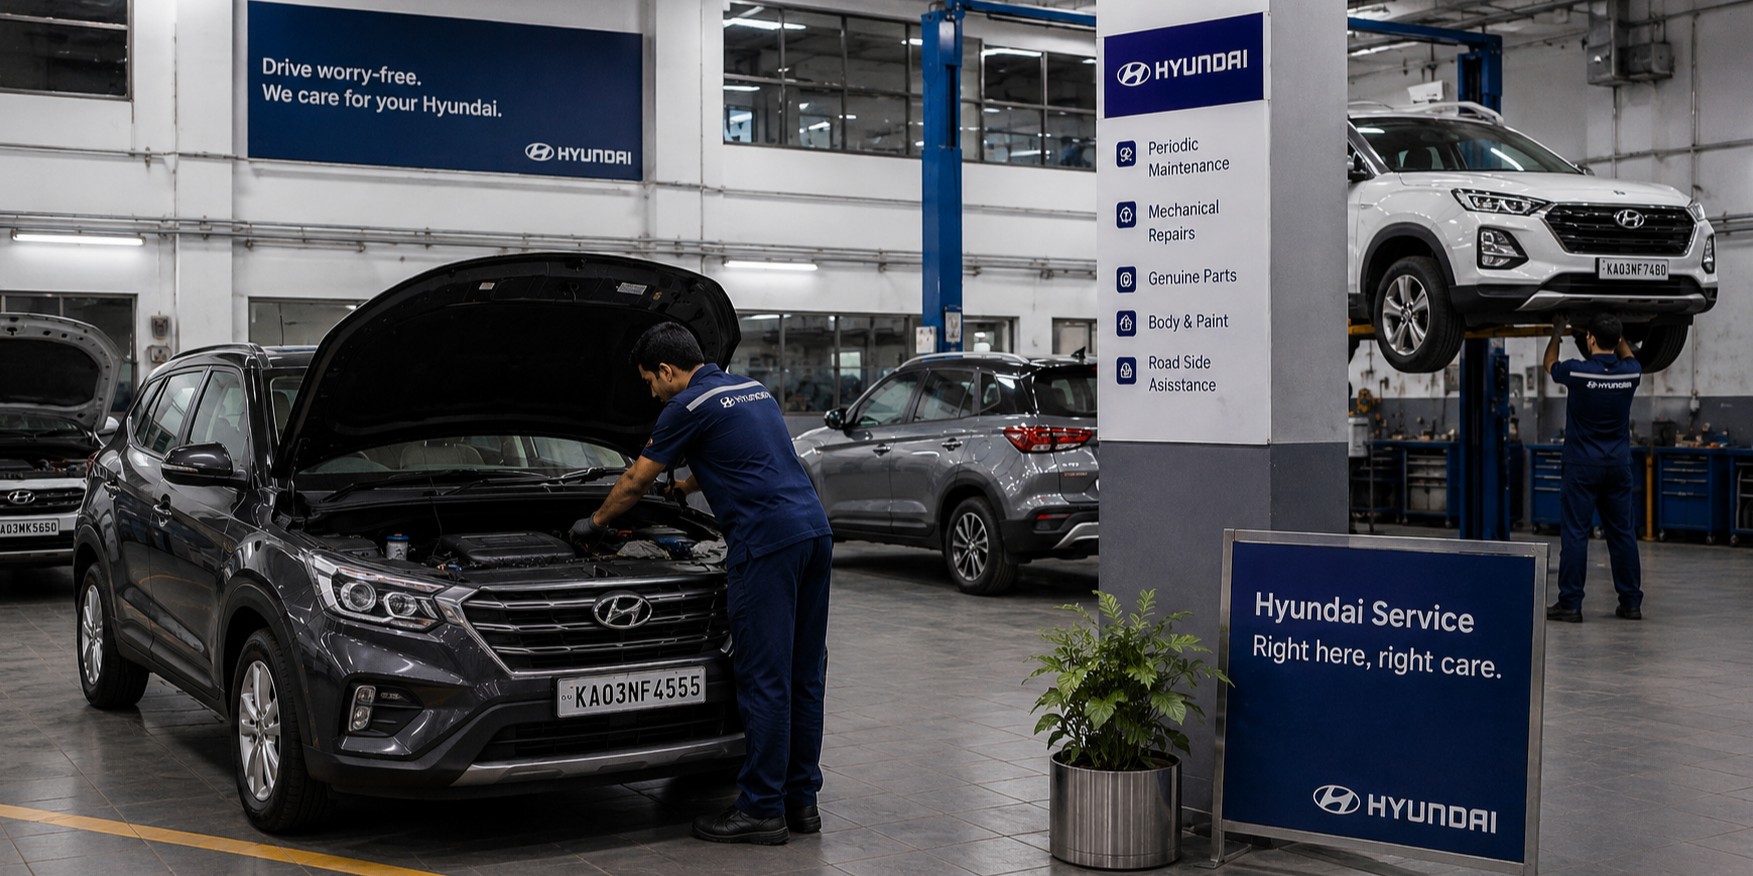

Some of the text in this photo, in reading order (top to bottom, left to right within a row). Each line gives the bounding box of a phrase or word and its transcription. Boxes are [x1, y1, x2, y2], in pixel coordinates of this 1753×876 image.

[263, 58, 422, 86] Drive worry-free.
[1156, 49, 1248, 80] HYUNDAI
[263, 84, 502, 118] We care for your Hyundai.
[557, 146, 632, 165] HYUNDAI
[1149, 138, 1199, 156] Periodic
[1149, 159, 1230, 177] Maintenance
[1149, 199, 1219, 219] Mechanical
[1149, 226, 1196, 245] Repairs
[1148, 269, 1237, 286] Genuine Parts
[1149, 313, 1229, 333] Body & Paint
[1149, 354, 1212, 370] Road Side
[1149, 377, 1217, 392] Asisstance
[1255, 591, 1475, 634] Hyundai Service
[1253, 634, 1502, 679] Right here, right care.
[575, 675, 700, 709] KA03NF4555
[1367, 793, 1497, 834] HYUNDAI
